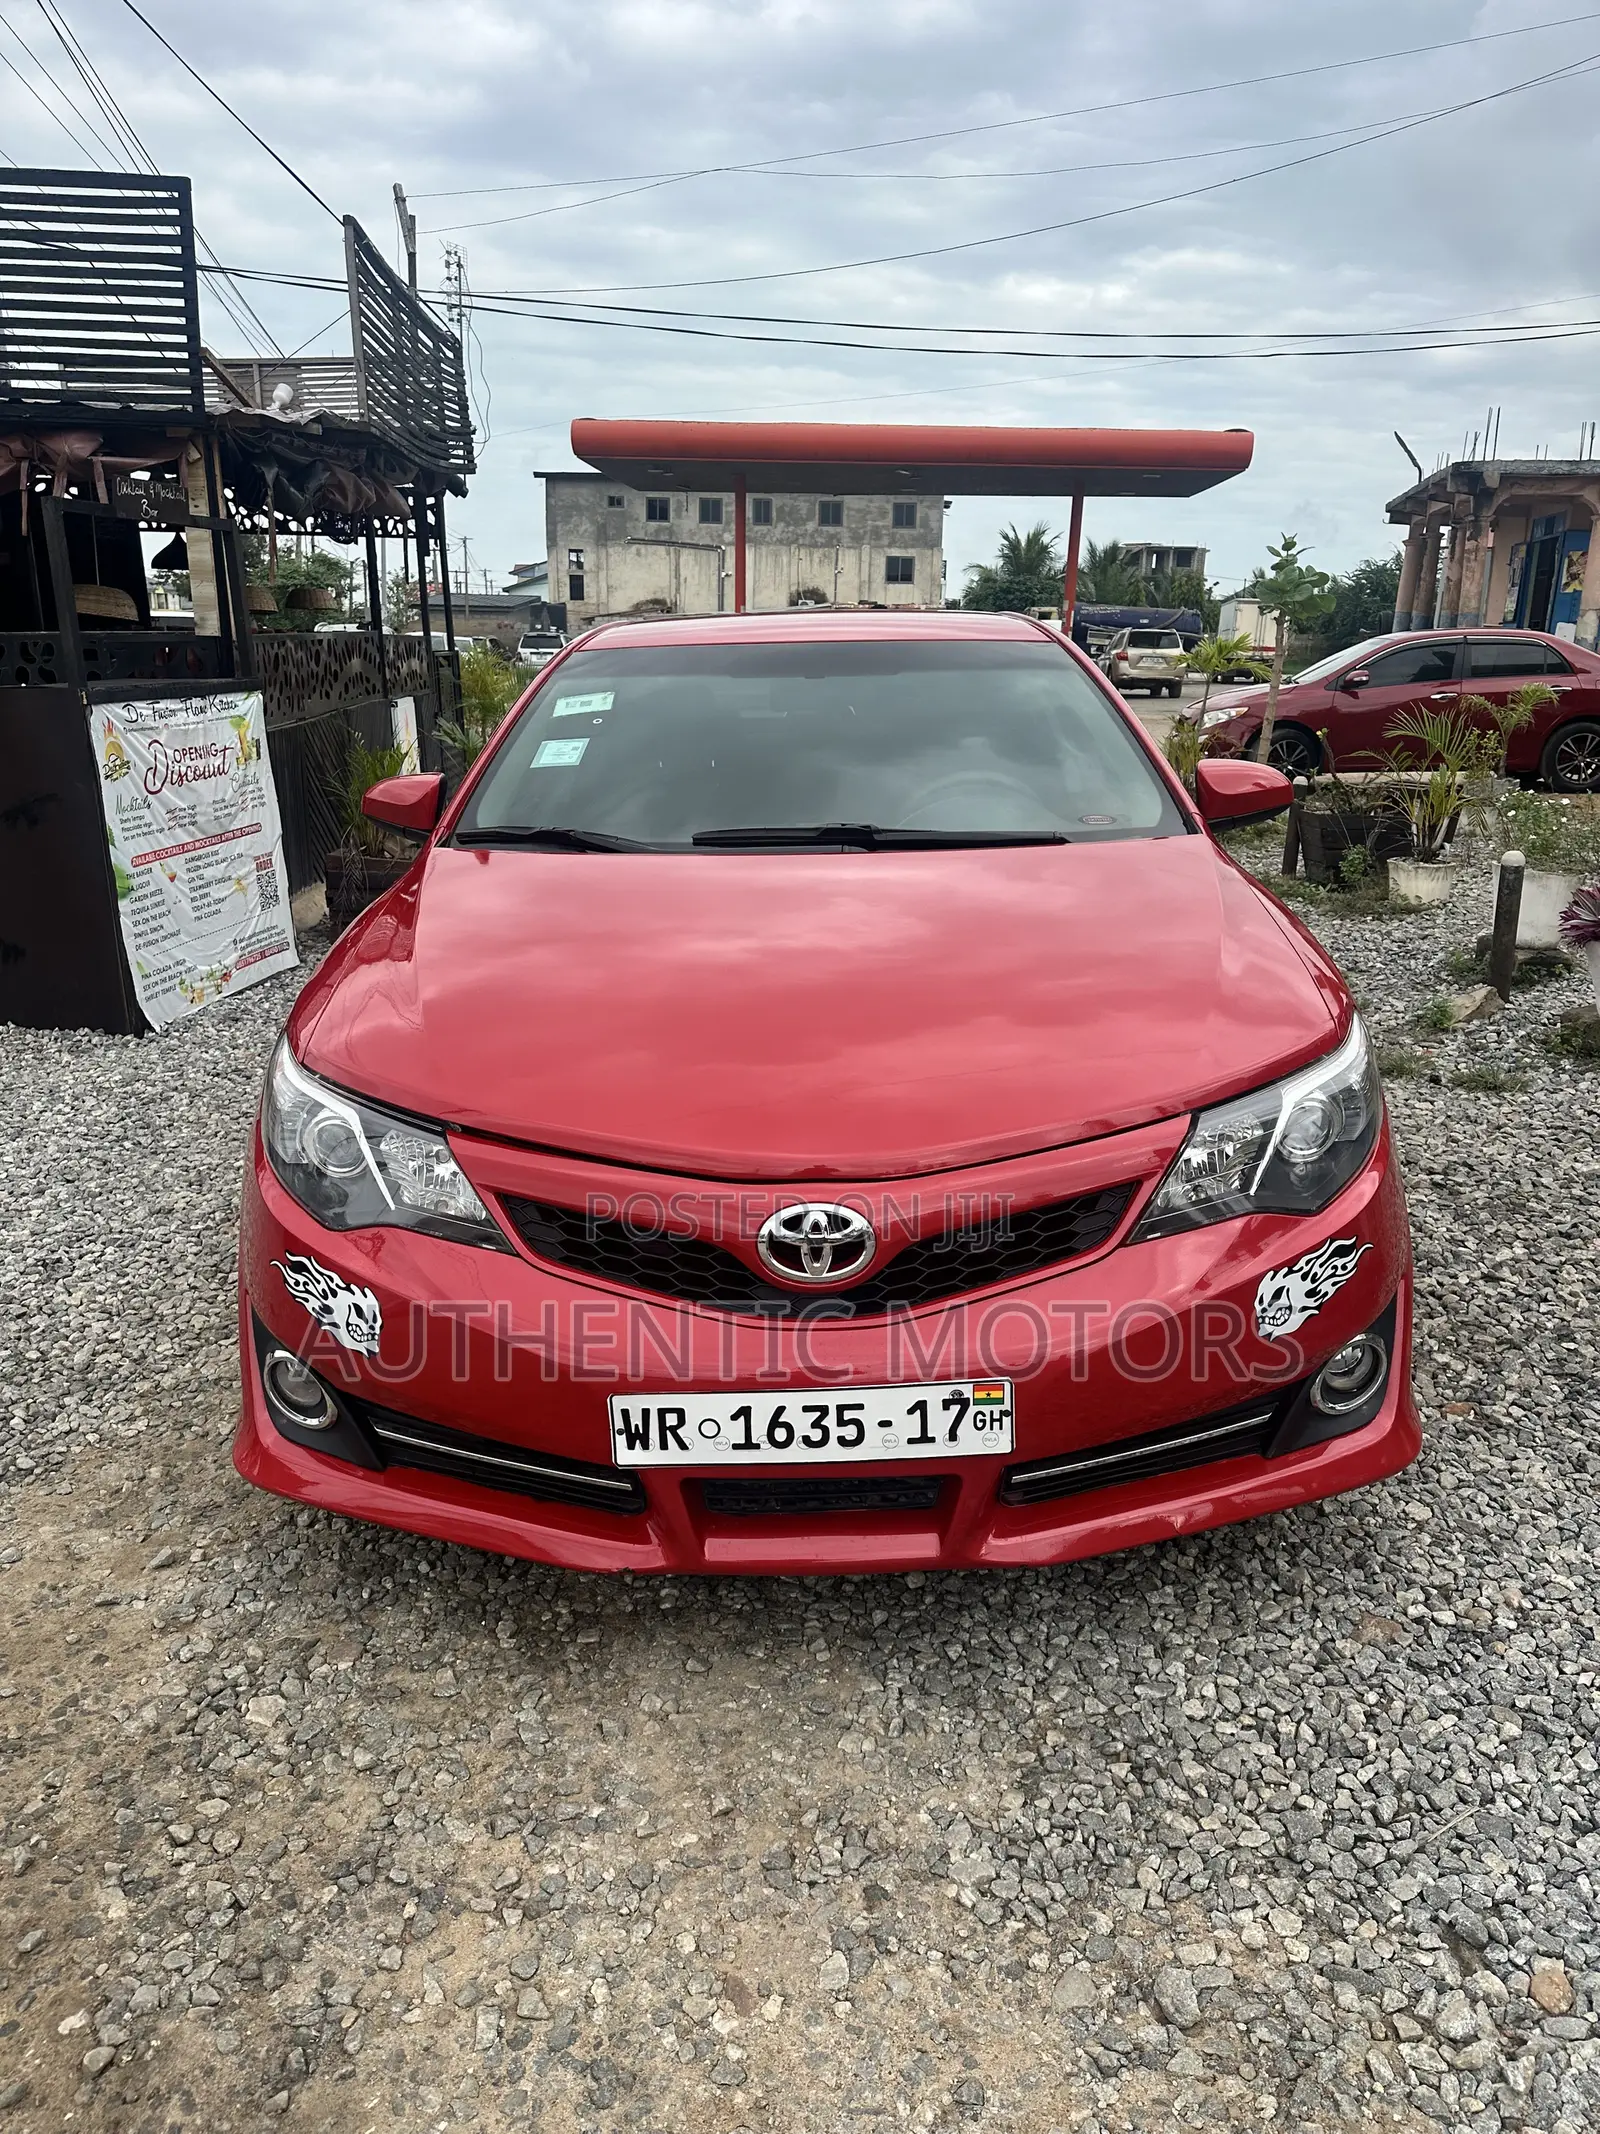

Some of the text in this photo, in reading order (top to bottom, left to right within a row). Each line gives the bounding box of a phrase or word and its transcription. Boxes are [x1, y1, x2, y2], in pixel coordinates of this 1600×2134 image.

[141, 499, 158, 518] Bar
[174, 743, 218, 764] OPENING
[144, 739, 234, 795] Discount
[115, 794, 152, 815] Mocktails
[156, 845, 183, 860] COCKTAILS
[184, 843, 195, 852] AND
[195, 836, 221, 849] MOCKTAILS
[221, 833, 233, 842] AFTER
[233, 830, 242, 838] THE
[242, 825, 262, 837] OPENING
[184, 853, 210, 865] DANGEROUS
[186, 865, 202, 874] FROZEN
[202, 861, 216, 870] LONG
[126, 872, 136, 881] THE
[188, 881, 214, 894] STRAWBERRY
[129, 894, 149, 904] GARDEN
[130, 905, 150, 916] TEQUILA
[132, 909, 172, 928] SEX ON THE BEACH
[204, 908, 222, 919] COLADA
[135, 938, 160, 951] DE-FUSION
[141, 972, 152, 981] PINA
[152, 964, 172, 977] COLADA
[143, 984, 151, 993] SEX
[151, 981, 159, 989] ON
[159, 978, 168, 987] THE
[168, 971, 184, 983] BEACH
[621, 1407, 690, 1451] WR
[972, 1409, 1004, 1431] GH
